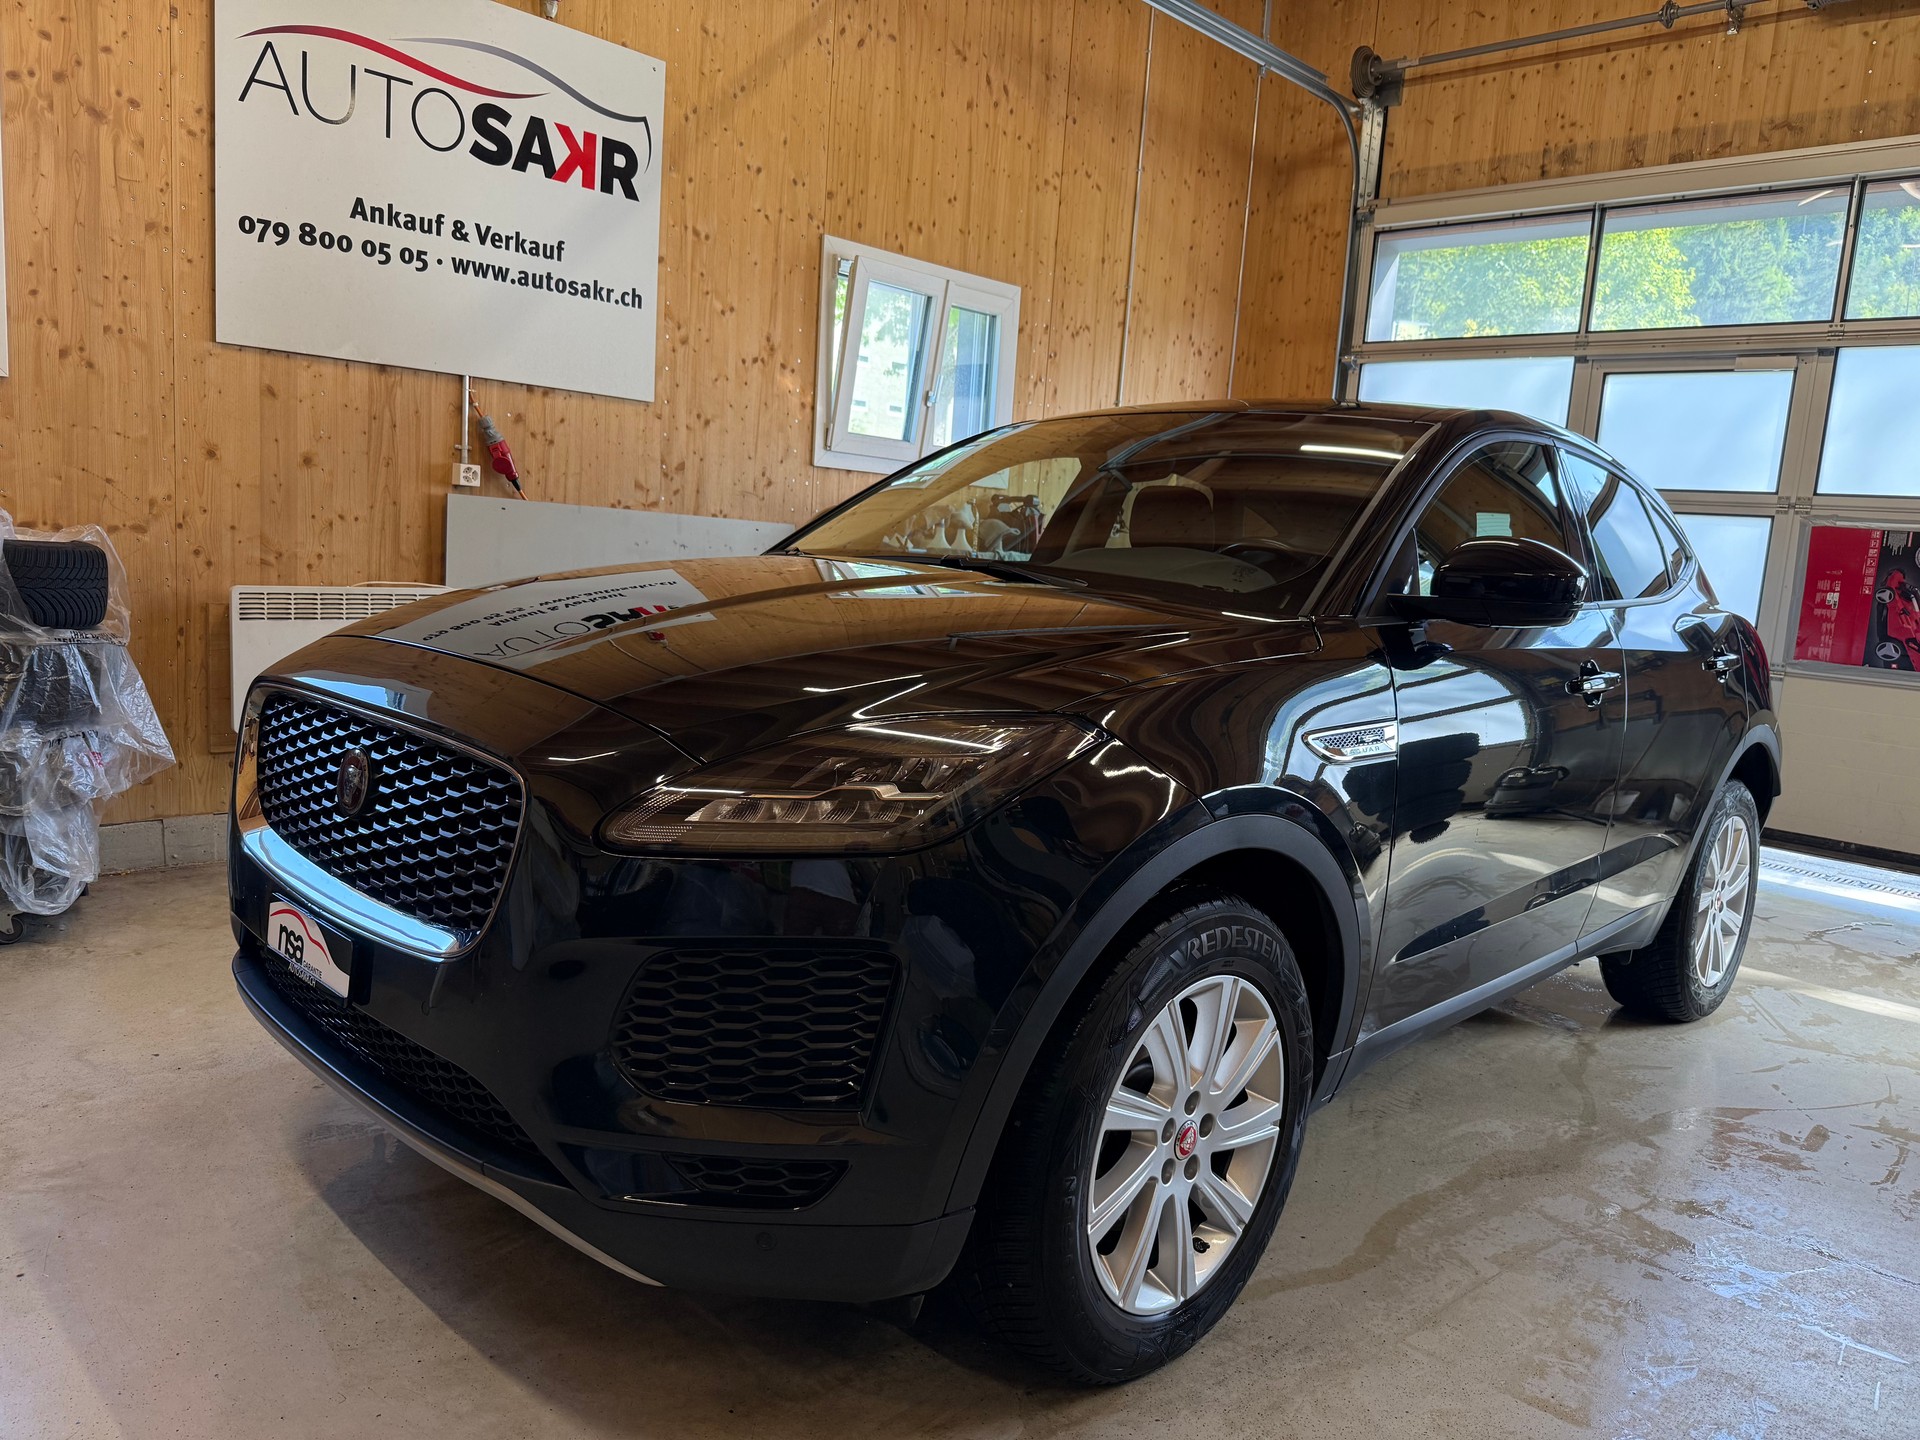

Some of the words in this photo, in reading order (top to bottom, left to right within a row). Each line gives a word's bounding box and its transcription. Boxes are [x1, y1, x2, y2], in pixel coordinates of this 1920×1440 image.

[349, 197, 445, 238] Ankauf
[451, 219, 470, 243] &
[475, 223, 566, 262] Verkauf
[238, 214, 290, 246] 079
[298, 222, 353, 253] 800
[361, 238, 392, 266] 05
[399, 245, 429, 272] 05
[451, 255, 643, 309] www.autosakr.ch
[278, 924, 304, 965] nsa
[1170, 925, 1286, 969] VREDESTEIN
